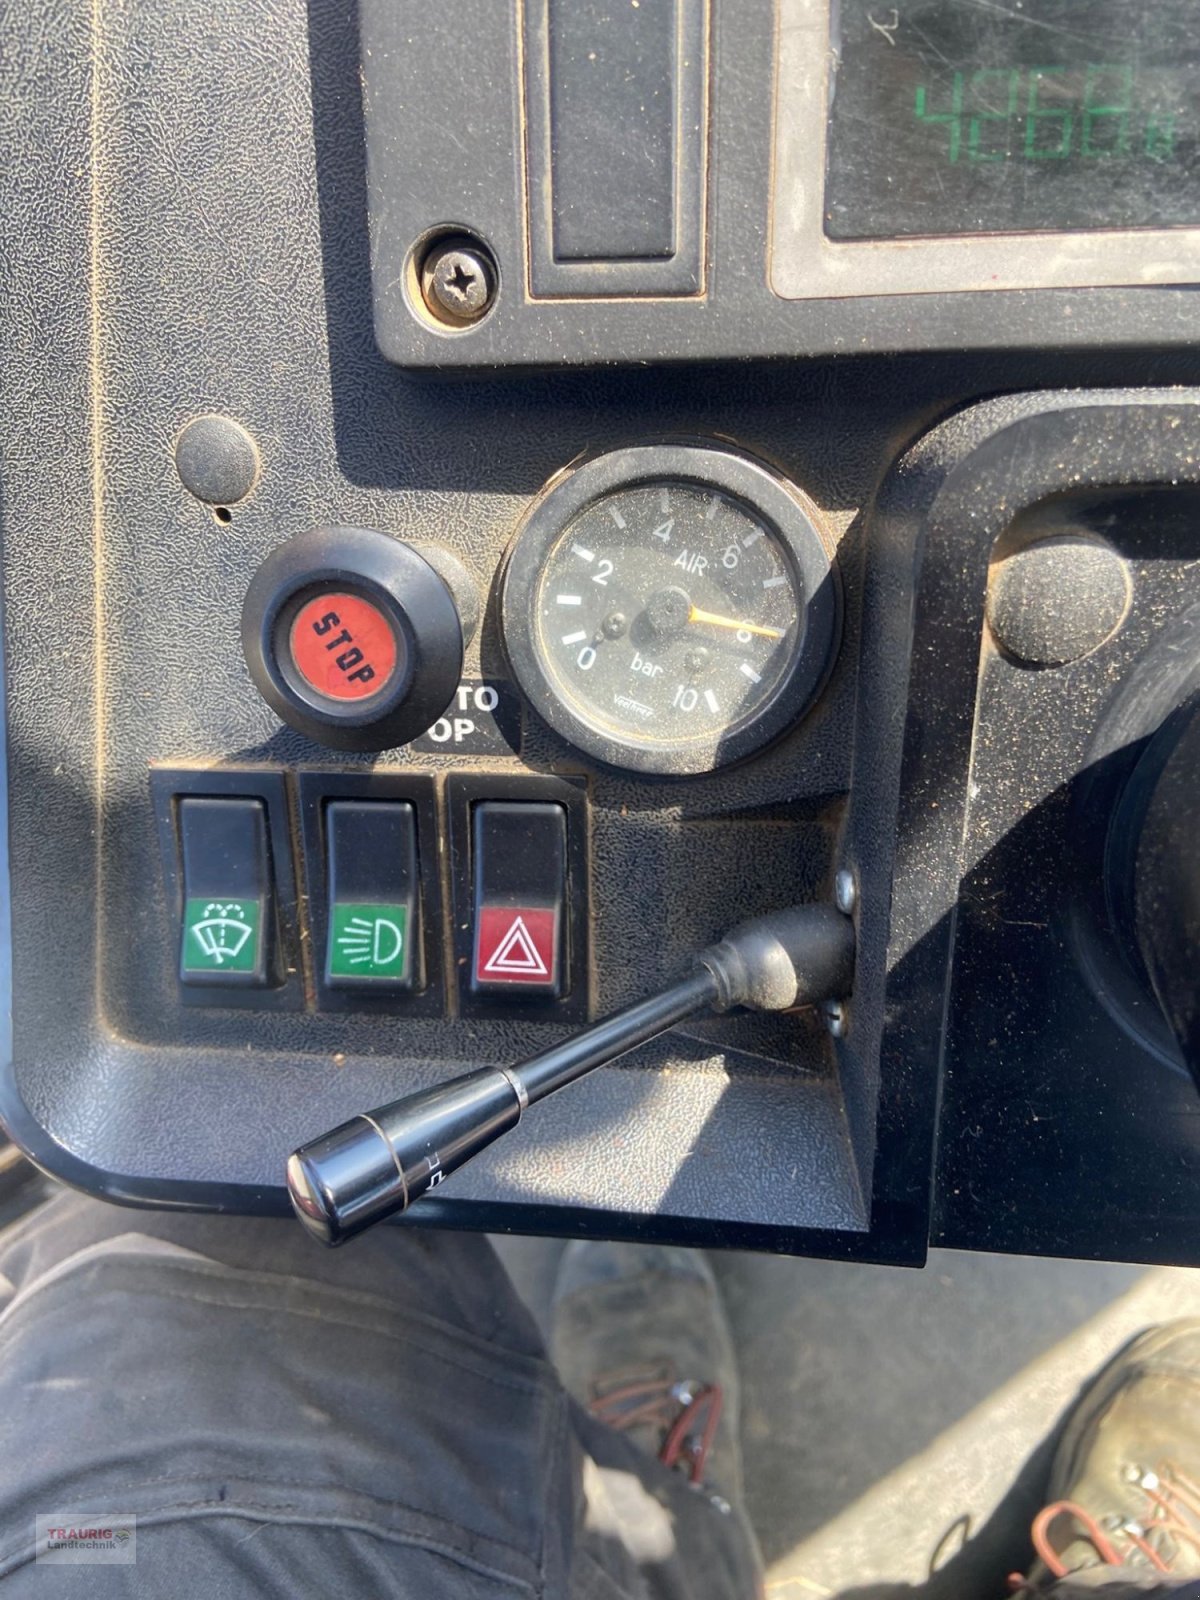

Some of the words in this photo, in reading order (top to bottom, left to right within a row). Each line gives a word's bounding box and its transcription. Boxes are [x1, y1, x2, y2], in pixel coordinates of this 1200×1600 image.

[653, 518, 675, 543] 4
[674, 549, 708, 577] AIR
[722, 545, 739, 569] 6
[592, 559, 613, 586] 2
[312, 611, 376, 684] STOP
[576, 646, 597, 671] 0
[630, 651, 663, 678] bar
[672, 684, 698, 712] 10
